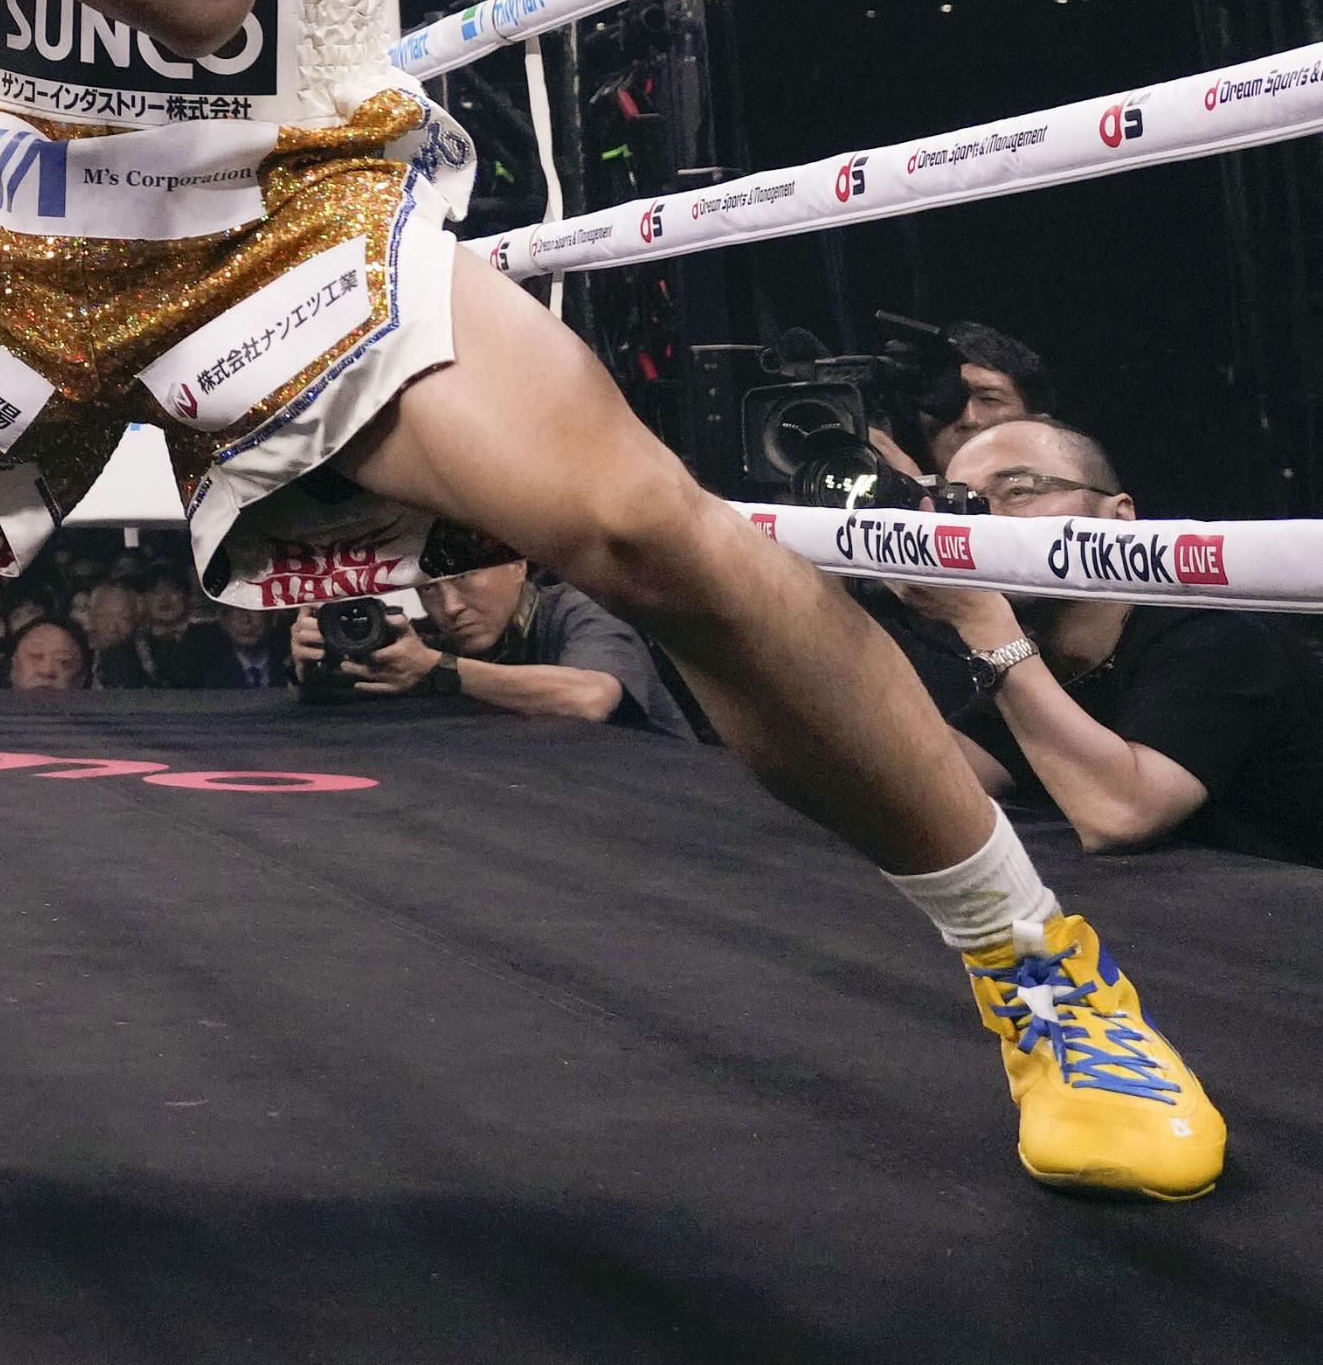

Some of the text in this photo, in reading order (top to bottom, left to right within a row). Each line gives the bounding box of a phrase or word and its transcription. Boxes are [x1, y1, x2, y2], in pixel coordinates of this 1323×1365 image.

[2, 72, 252, 120] サンコーインダストリー株式会社
[1220, 78, 1264, 103] Dream
[1265, 69, 1310, 96] Sports
[1310, 60, 1322, 84] &
[918, 150, 948, 168] Dream
[986, 125, 1048, 152] Management
[83, 167, 253, 191] M's Corporation
[196, 269, 359, 395] 株式会社ナンエツ工業
[860, 521, 968, 567] TikTok LIVE
[1076, 531, 1220, 585] TikTok LIVE
